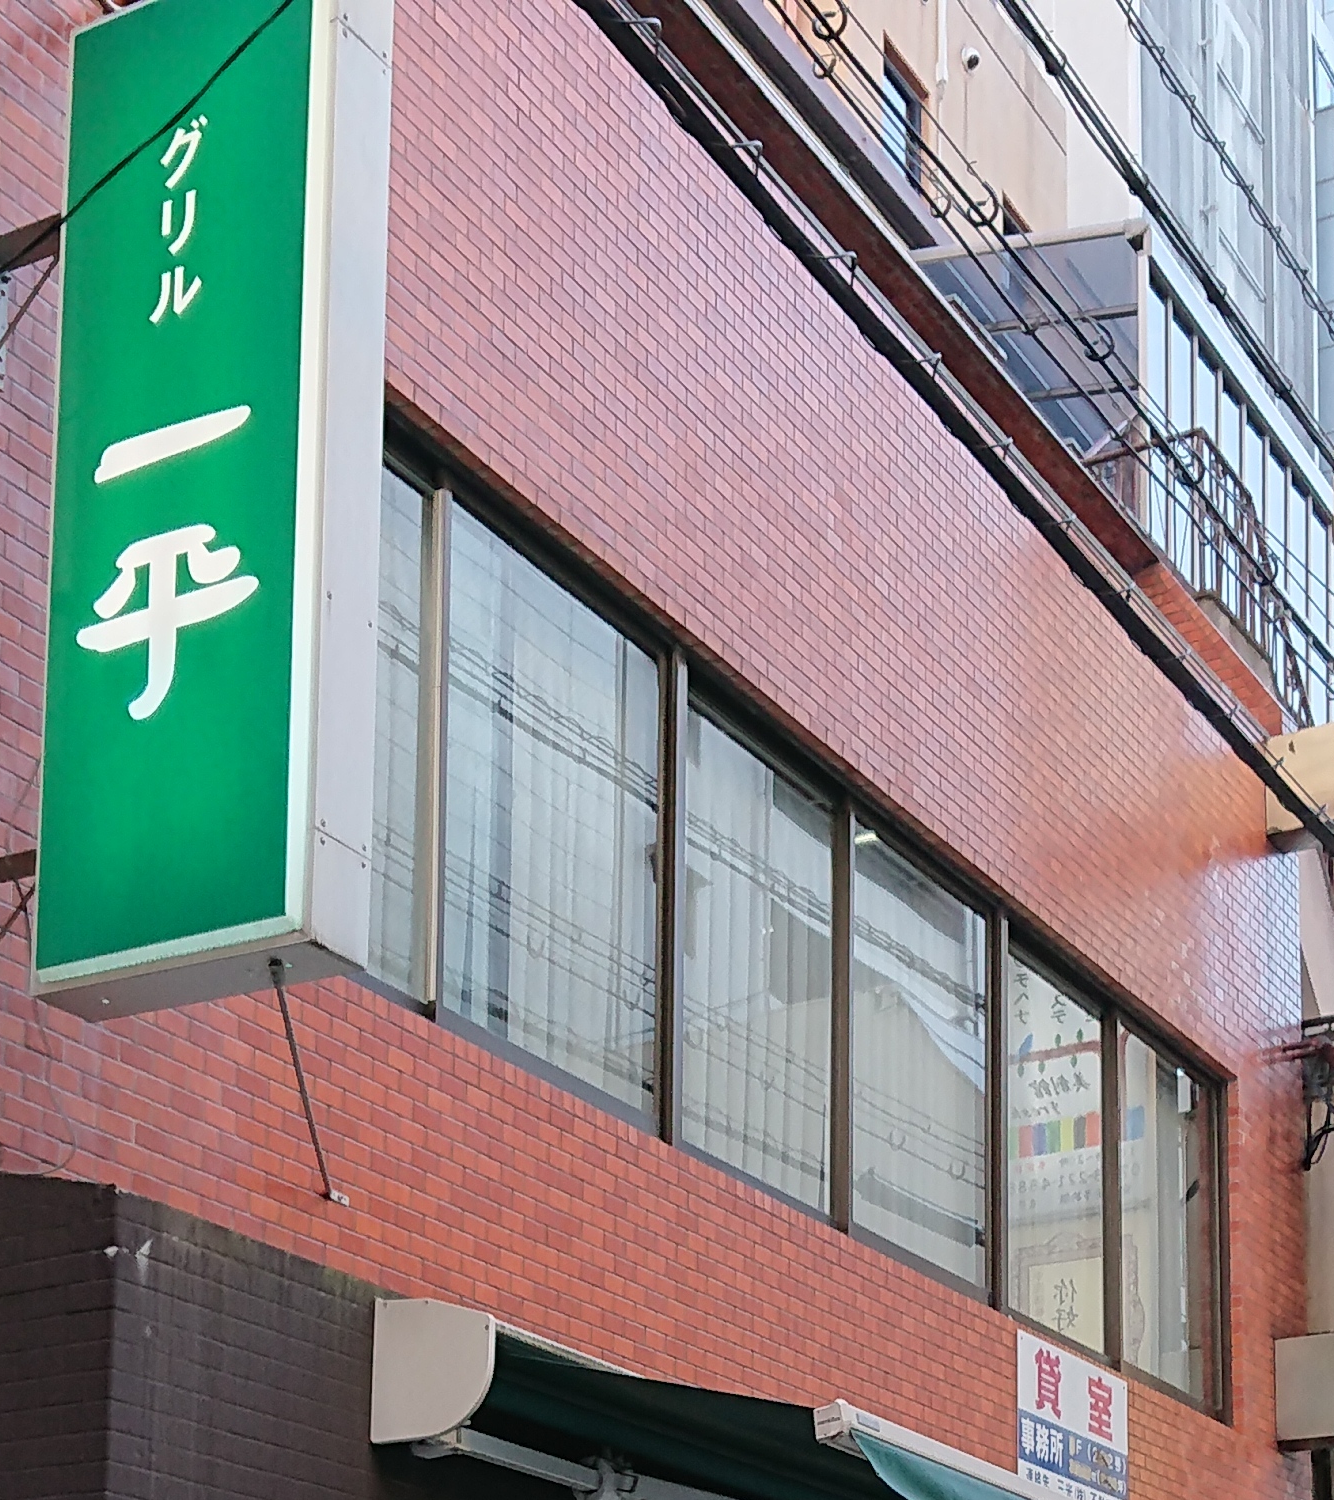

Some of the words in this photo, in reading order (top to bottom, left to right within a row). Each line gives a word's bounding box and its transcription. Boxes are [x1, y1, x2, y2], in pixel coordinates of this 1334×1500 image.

[149, 115, 209, 324] グリル
[75, 404, 260, 721] 一平
[1021, 1418, 1064, 1469] 事務所
